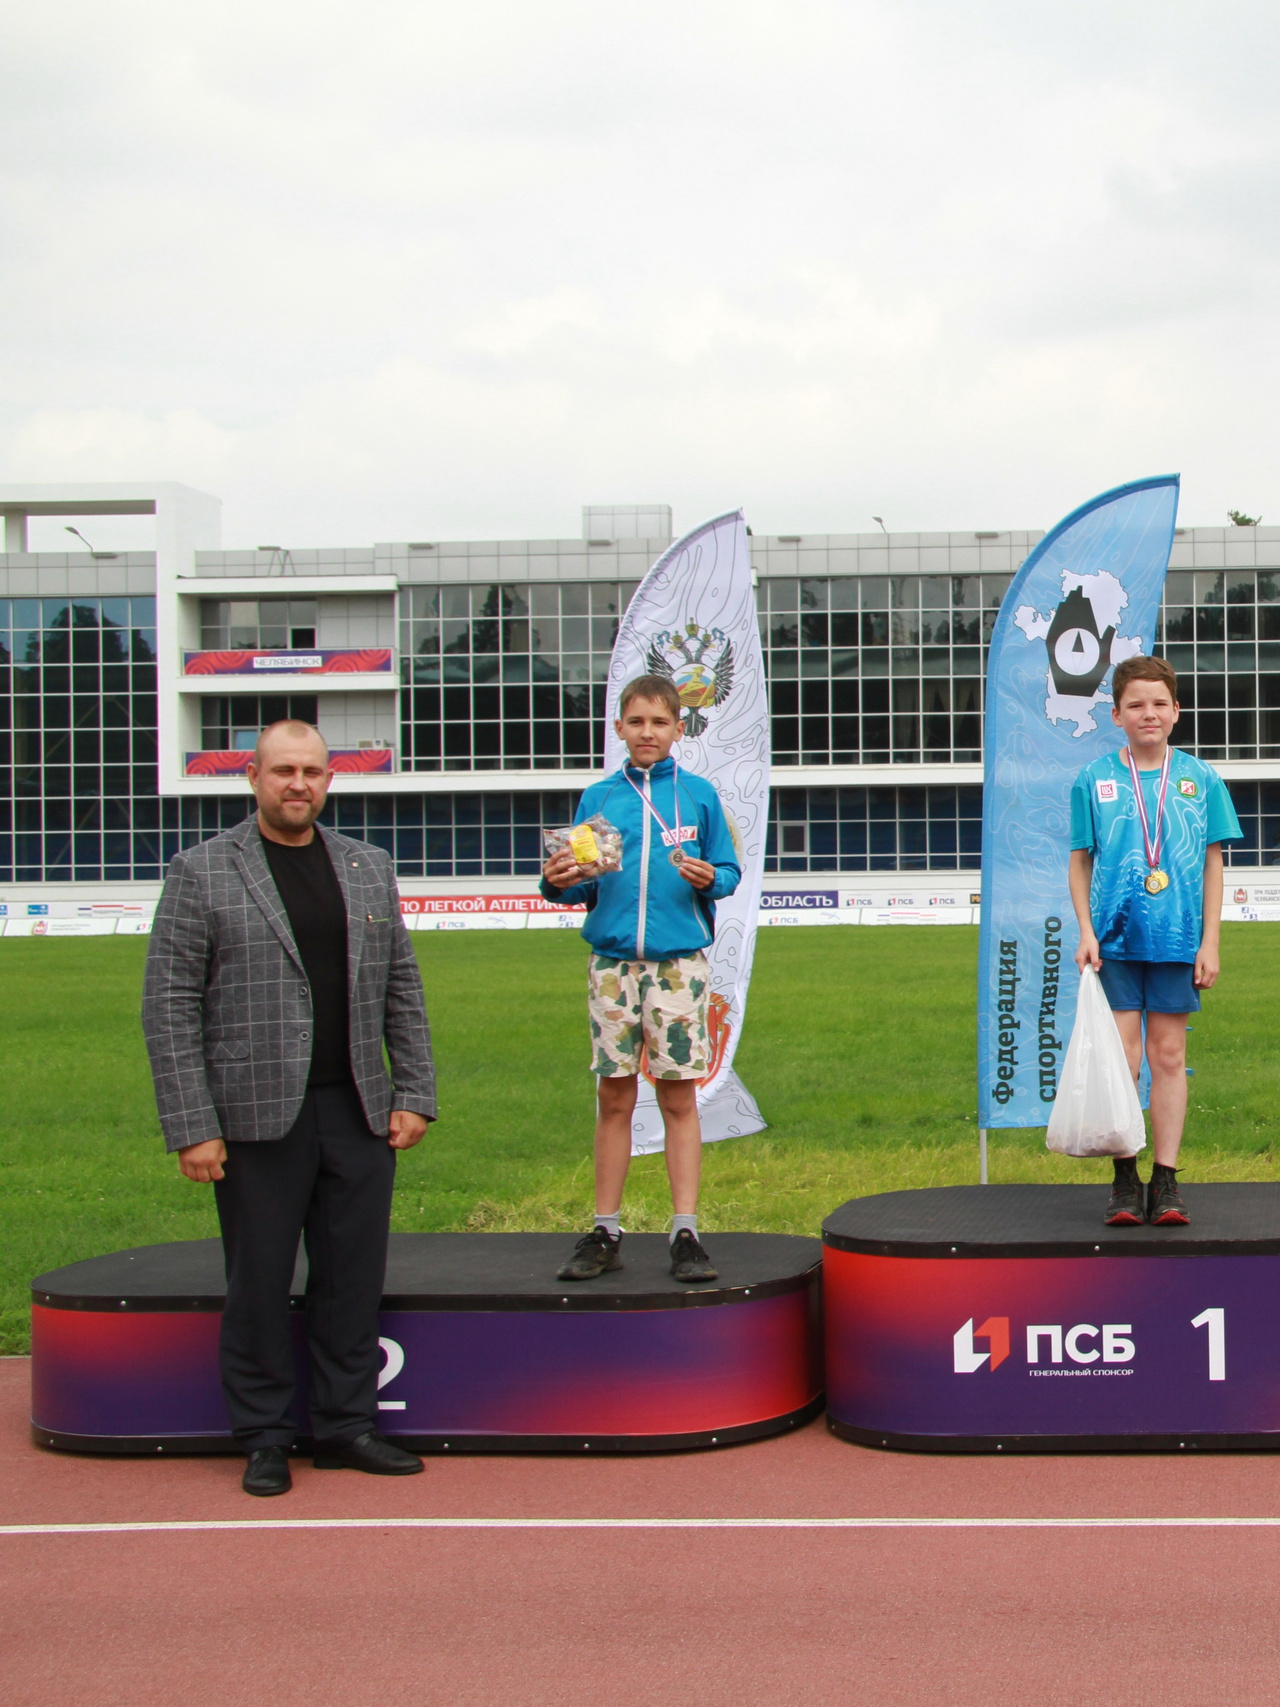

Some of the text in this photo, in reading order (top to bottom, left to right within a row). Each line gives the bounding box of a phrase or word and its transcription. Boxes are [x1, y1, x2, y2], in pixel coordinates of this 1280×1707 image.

[255, 657, 321, 667] ЧЕЛЯБИНСК
[424, 897, 486, 912] ЛЕГКОЙ
[760, 895, 833, 908] ОБЛАСТЬ
[856, 898, 873, 906] ПСБ
[897, 898, 914, 906] ПСБ
[1038, 916, 1063, 1103] спортивного
[991, 939, 1021, 1105] Федерация
[1026, 1323, 1136, 1364] ПСБ
[1190, 1307, 1226, 1381] 1
[1029, 1368, 1134, 1377] ГЕНЕРАЛЬНЫЙ СПОНСОР
